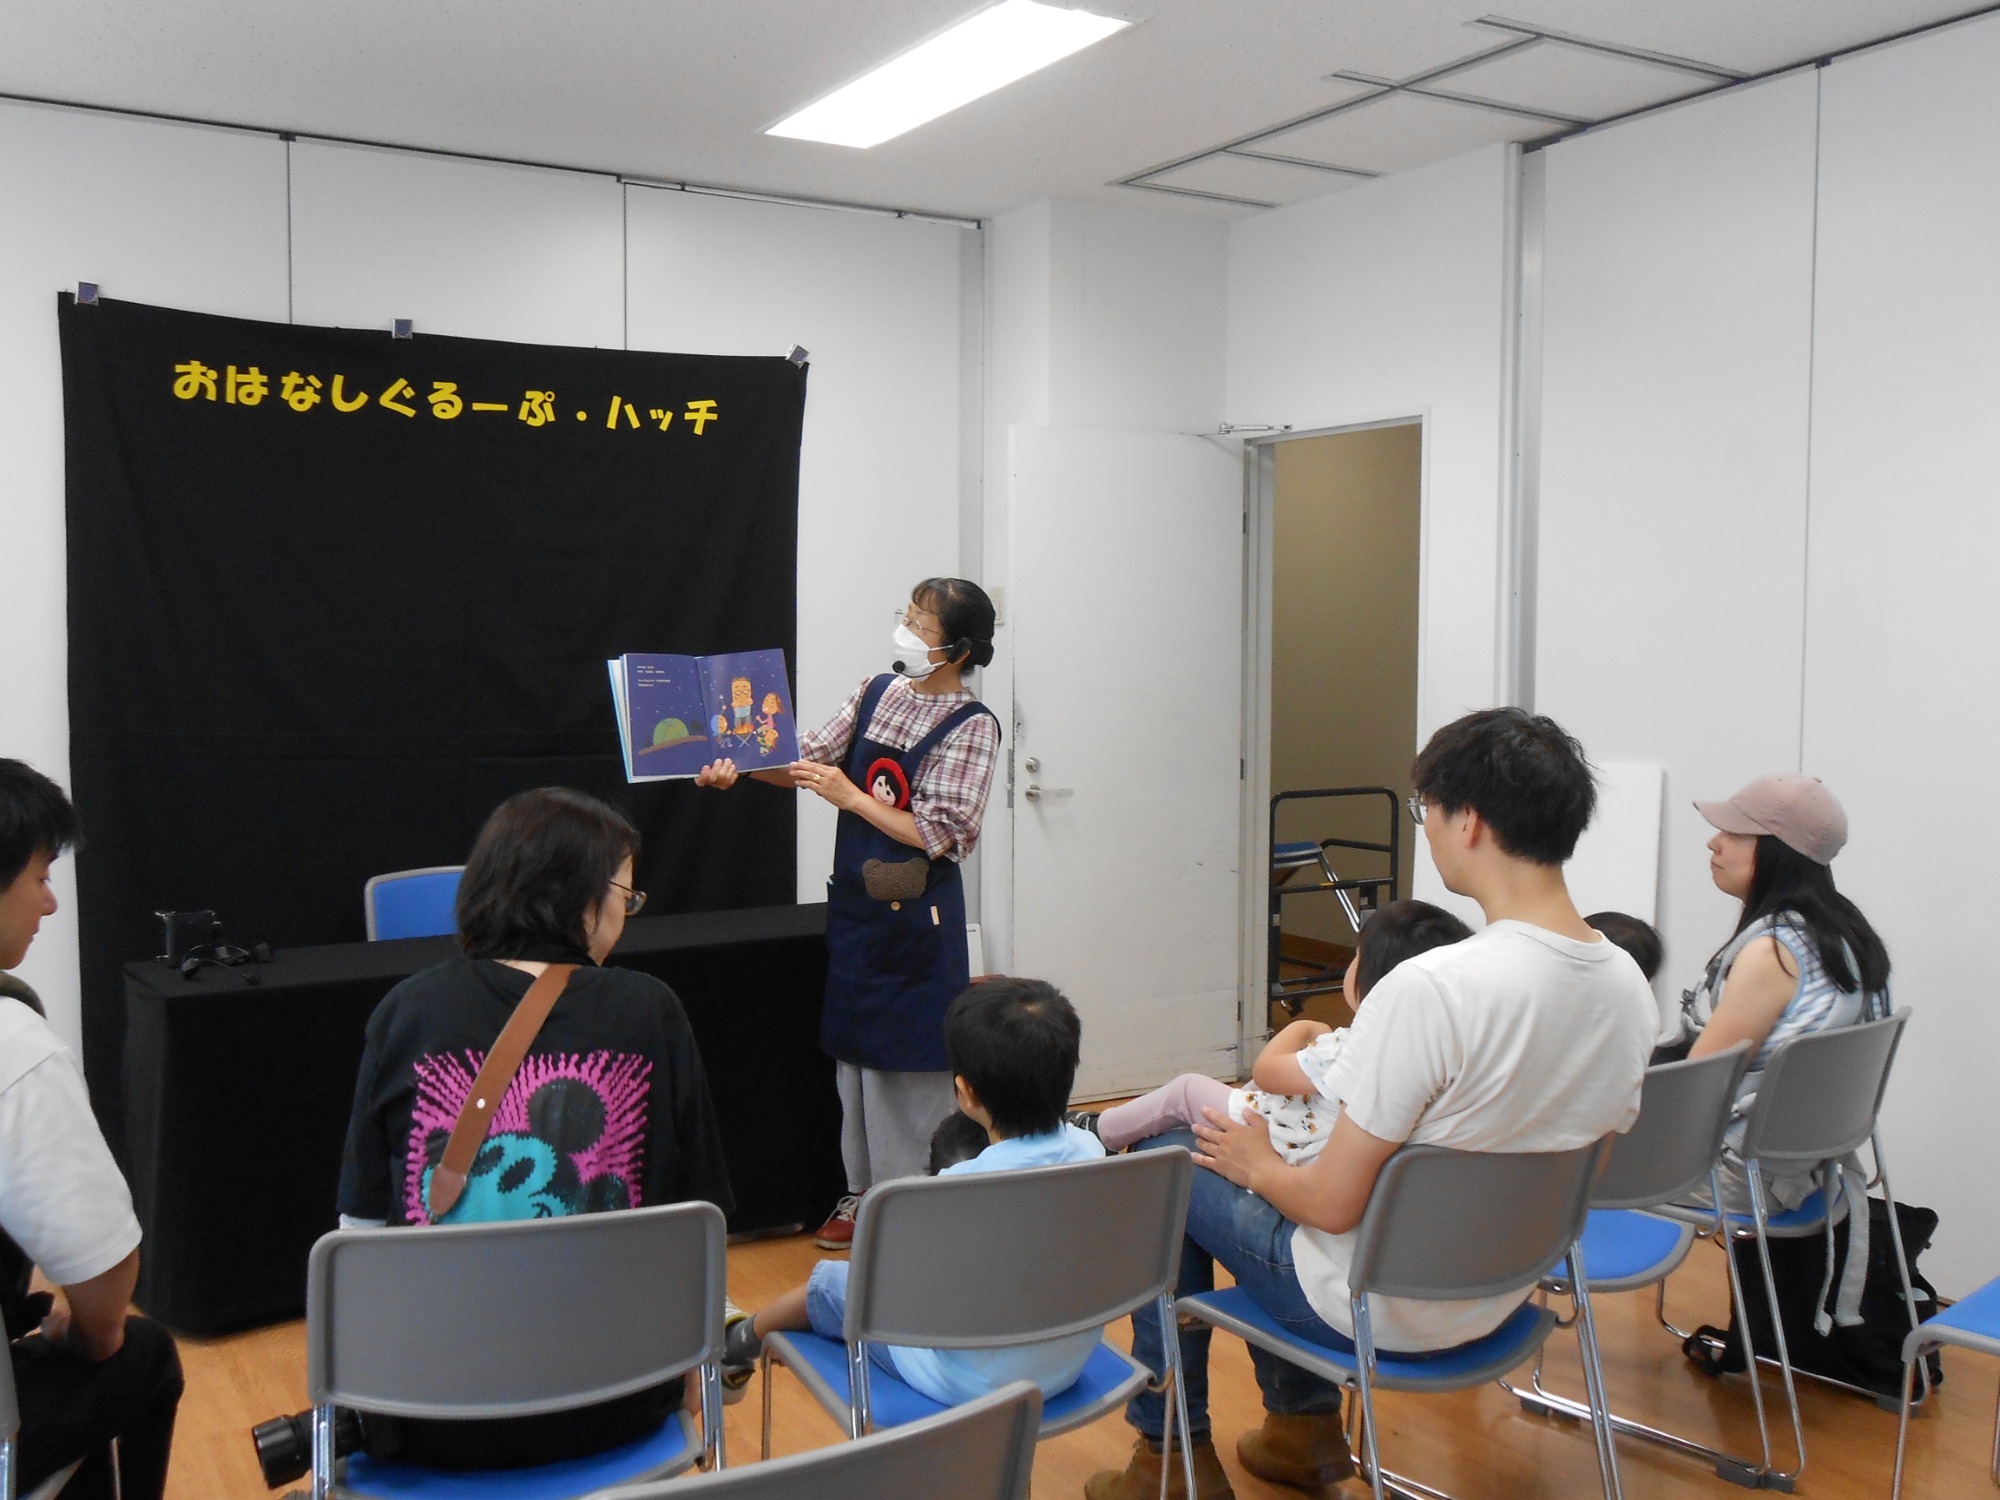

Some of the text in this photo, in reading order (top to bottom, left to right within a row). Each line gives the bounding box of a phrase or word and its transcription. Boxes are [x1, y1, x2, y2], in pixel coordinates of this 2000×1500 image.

[172, 360, 718, 435] おはなしぐるーぷ・ハッチ
